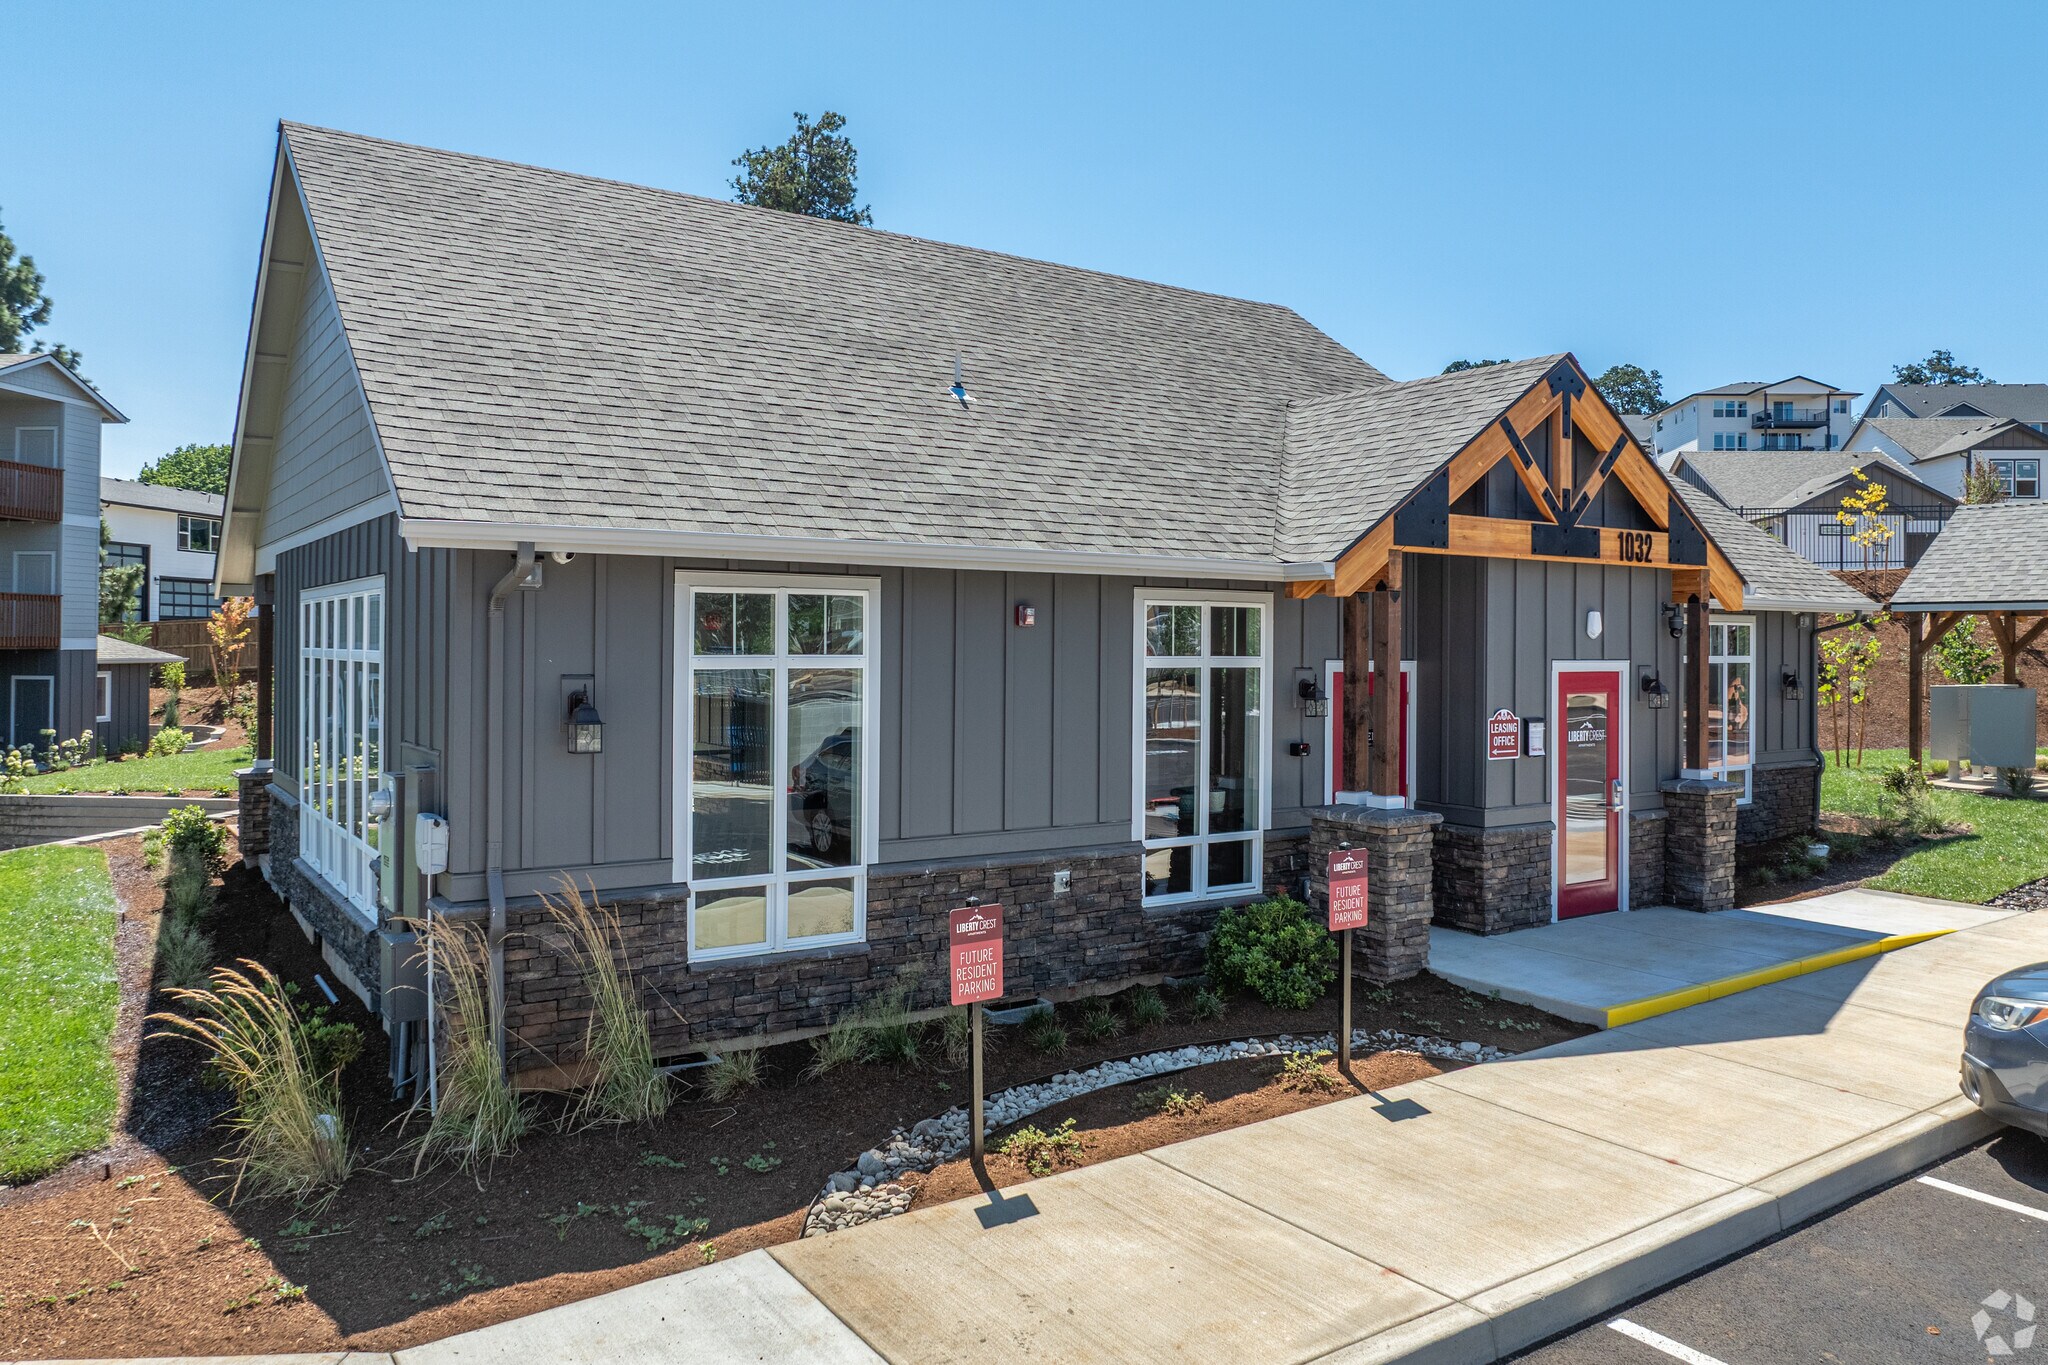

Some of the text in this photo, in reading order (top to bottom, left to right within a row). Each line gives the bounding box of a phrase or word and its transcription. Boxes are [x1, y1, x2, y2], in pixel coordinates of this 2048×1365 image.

[1617, 531, 1653, 563] 1032
[1491, 723, 1517, 734] LEASING
[1568, 729, 1605, 742] LIBERTY CREST
[1493, 736, 1515, 746] OFFICE
[1333, 862, 1350, 872] LIBERTY
[1336, 884, 1361, 898] FUTURE
[1333, 896, 1364, 911] RESIDENT
[1334, 909, 1363, 924] PARKING
[956, 918, 997, 934] LIBERTY CREST
[960, 947, 994, 966] FUTURE
[956, 962, 997, 981] RESIDENT
[958, 978, 995, 996] PARKING
